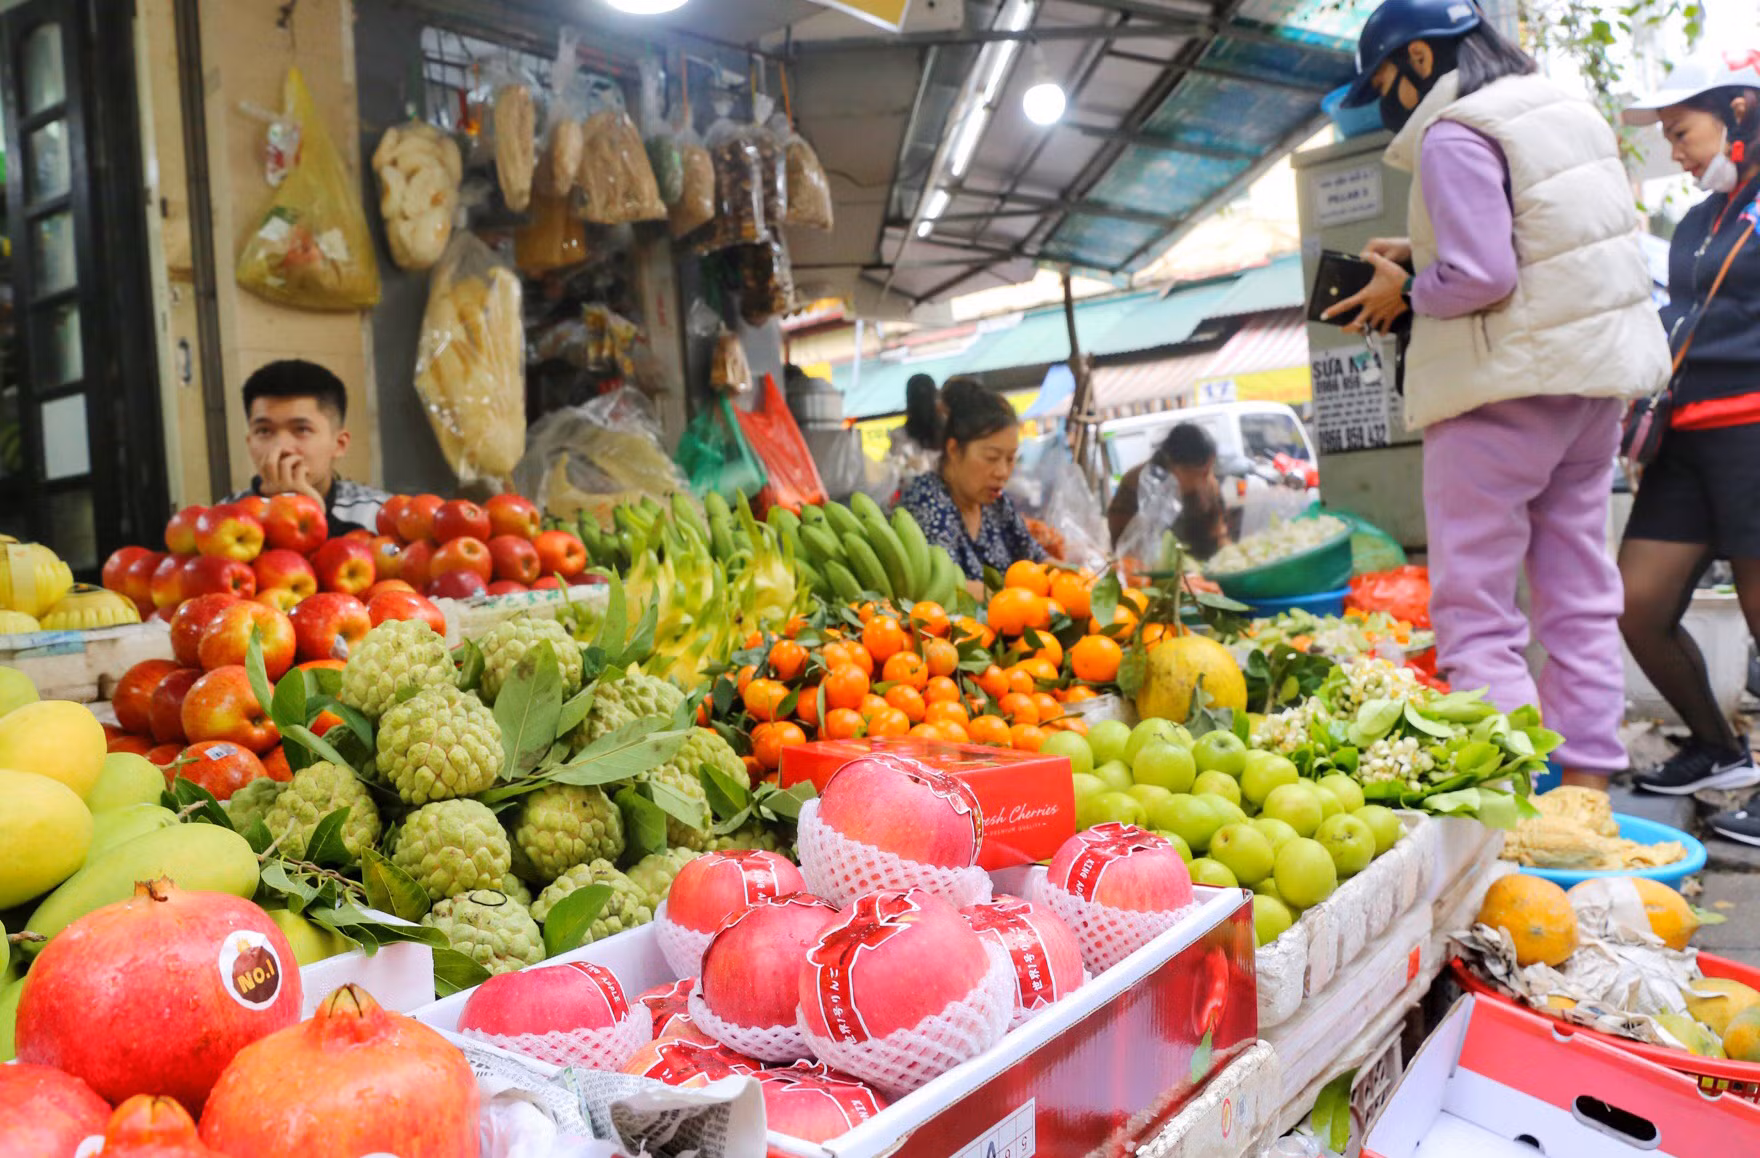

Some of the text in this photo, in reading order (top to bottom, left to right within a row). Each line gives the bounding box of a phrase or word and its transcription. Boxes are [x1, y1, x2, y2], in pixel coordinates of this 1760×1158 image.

[1009, 803, 1059, 824] Cherries
[1075, 858, 1095, 897] KING APP
[237, 958, 275, 994] NO.1
[601, 977, 621, 1003] APPLE
[851, 1099, 870, 1119] KIN
